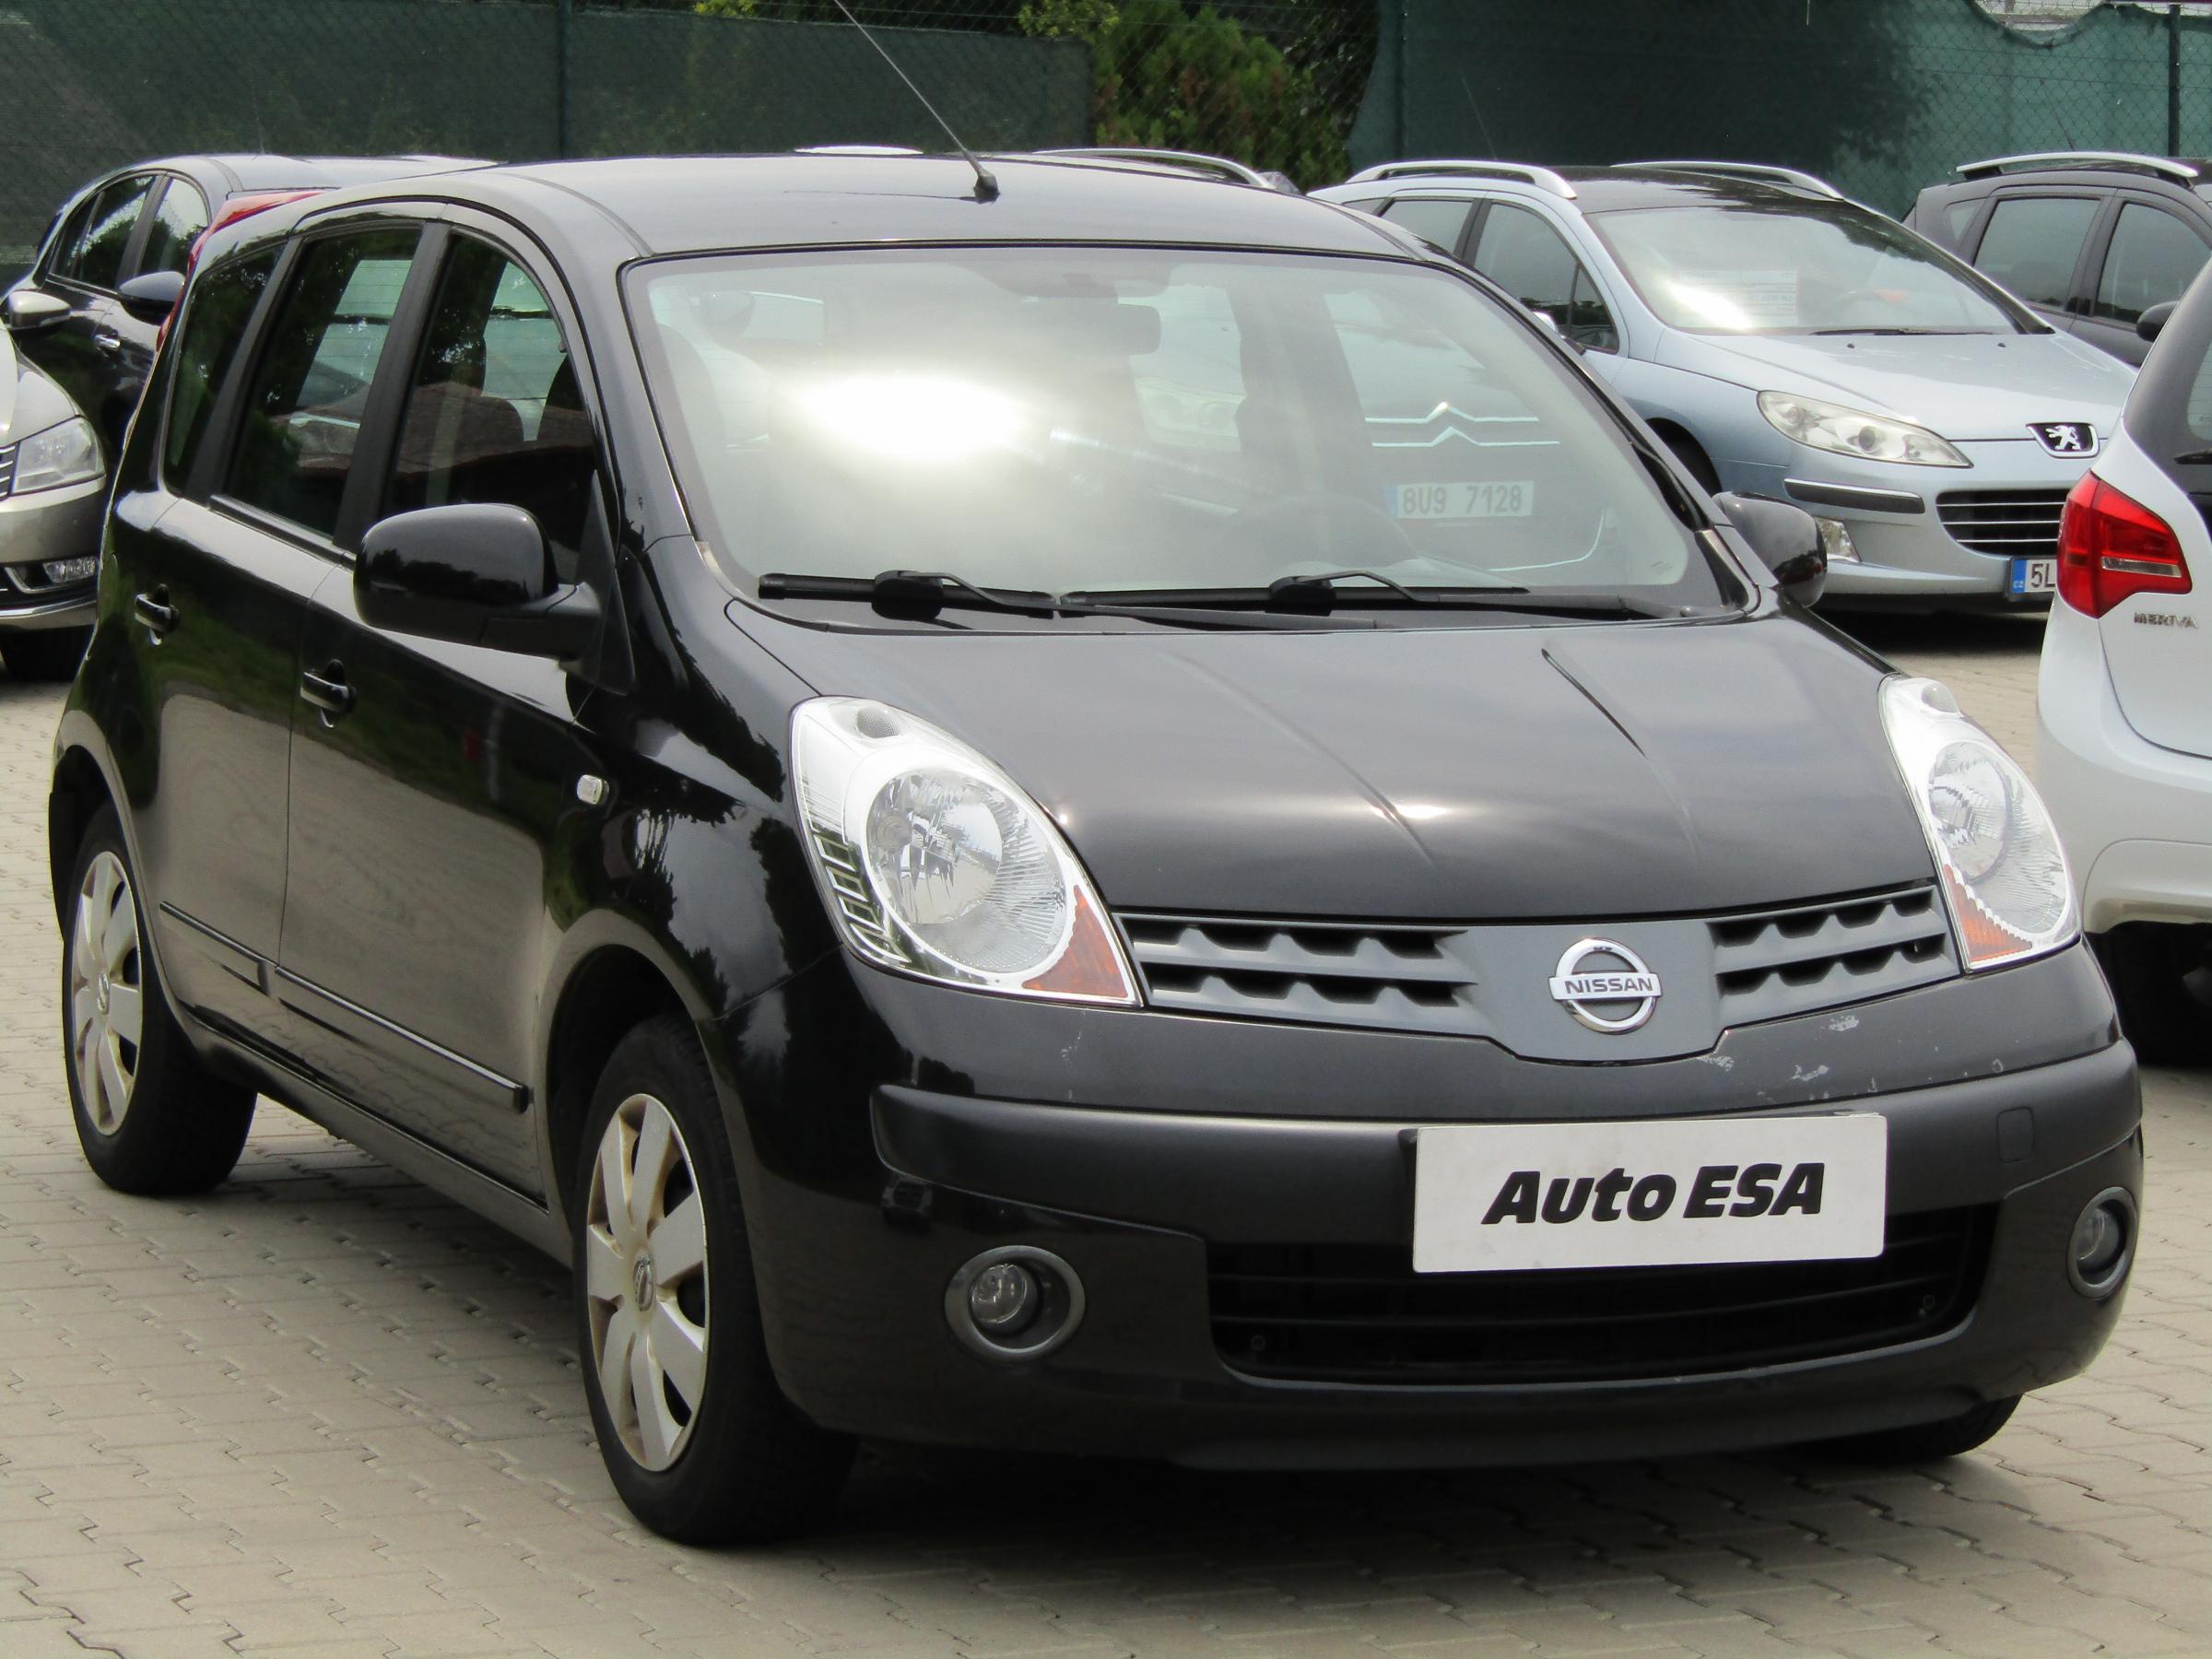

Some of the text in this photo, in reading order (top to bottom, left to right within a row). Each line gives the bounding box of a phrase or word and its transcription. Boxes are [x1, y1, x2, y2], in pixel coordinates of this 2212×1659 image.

[1402, 485, 1523, 514] 8U9 7128
[2134, 612, 2197, 628] MERIVA
[1564, 977, 1653, 994] NISSAN
[1480, 1162, 1825, 1225] Auto ESA
